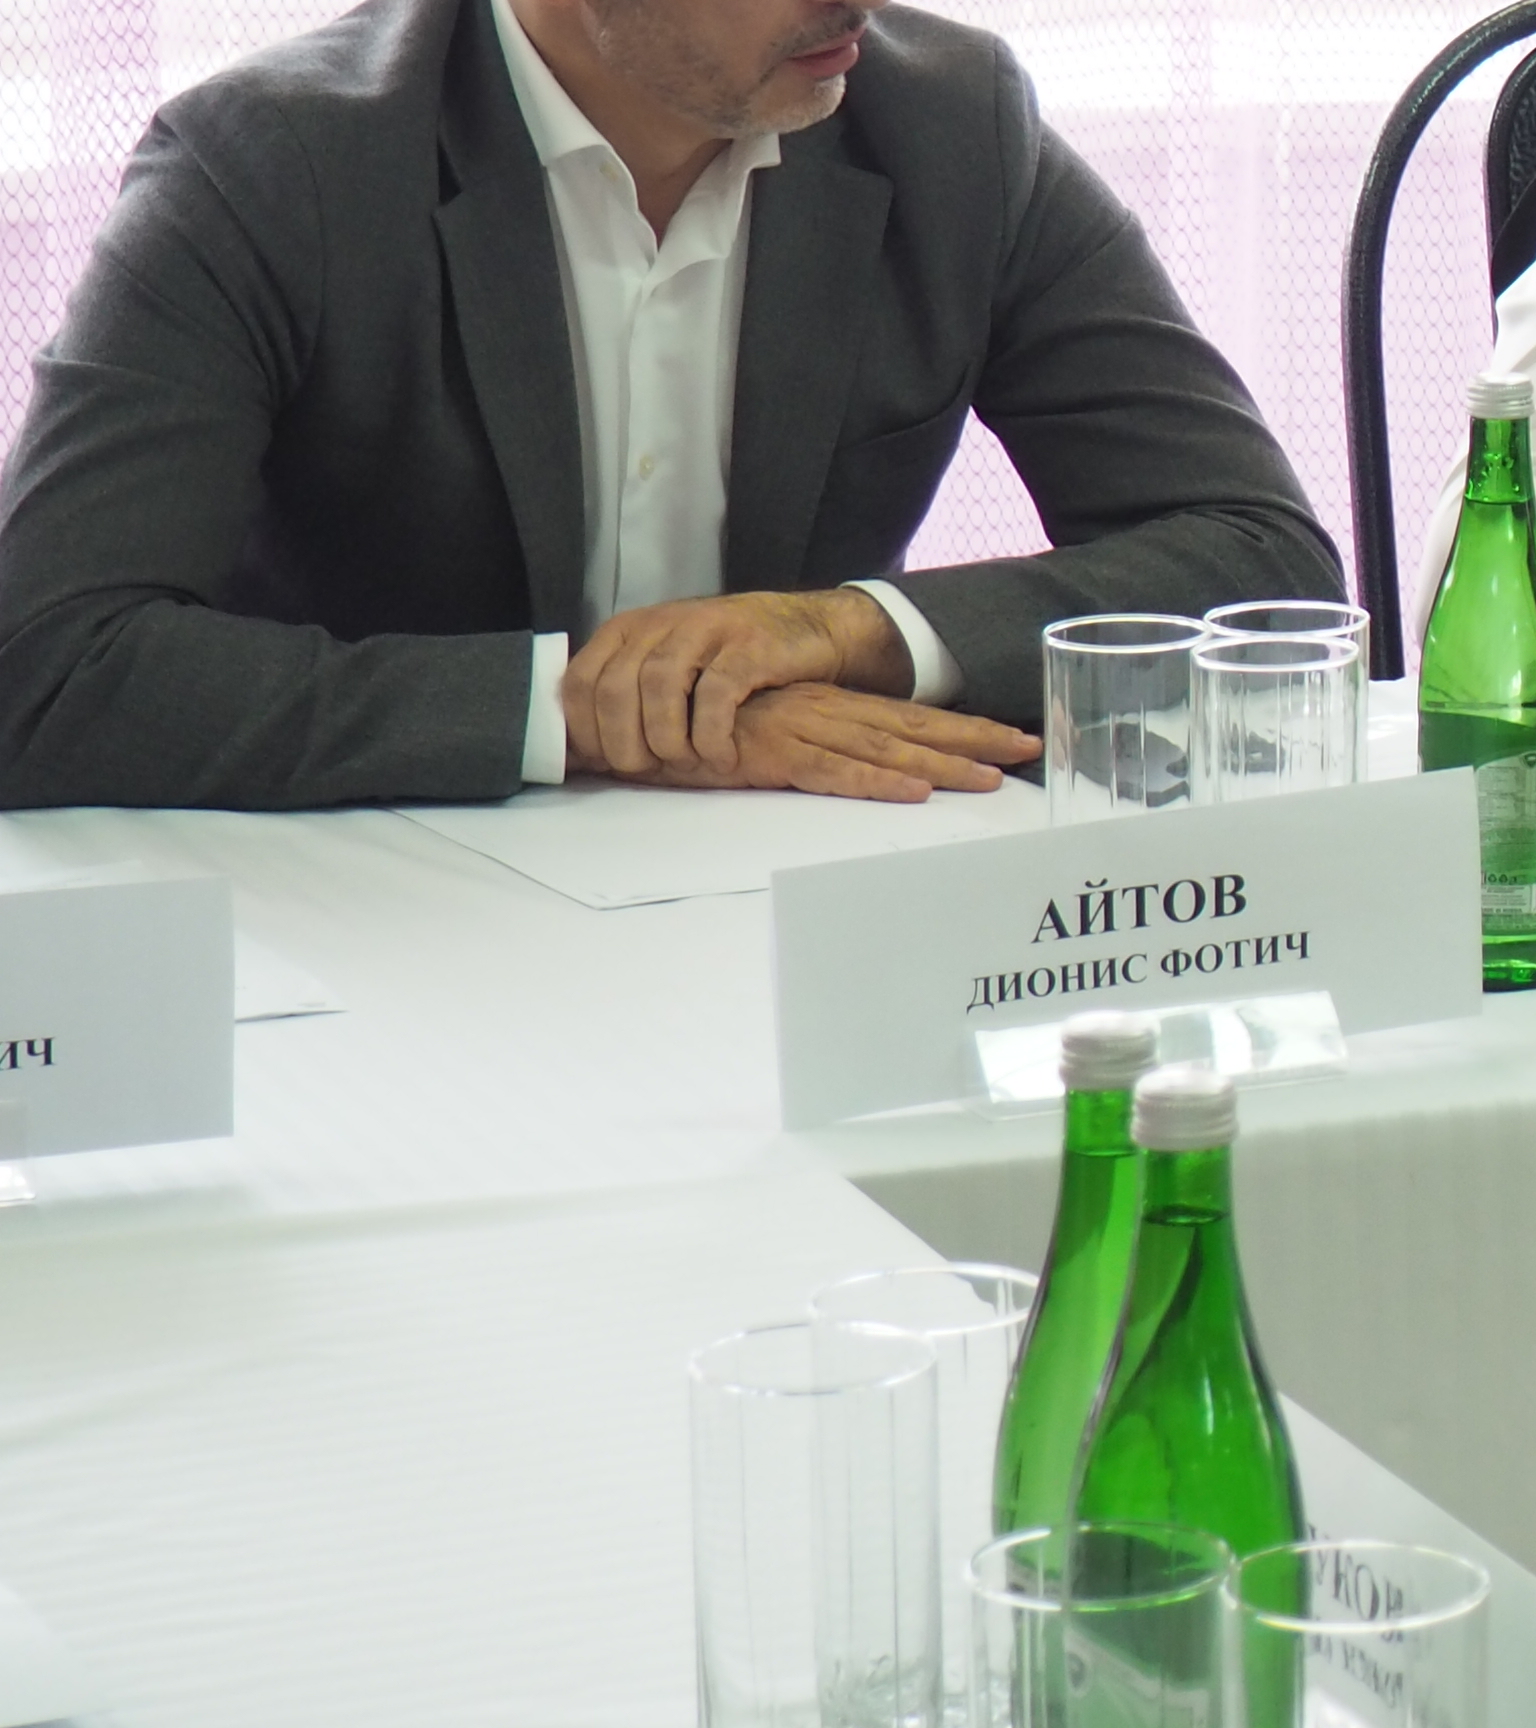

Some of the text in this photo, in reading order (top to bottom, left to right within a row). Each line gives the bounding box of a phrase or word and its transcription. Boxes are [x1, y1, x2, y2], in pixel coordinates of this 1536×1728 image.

[1031, 873, 1248, 944] АЙТОВ
[966, 930, 1310, 1015] ДИОНИС ФОТИЧ
